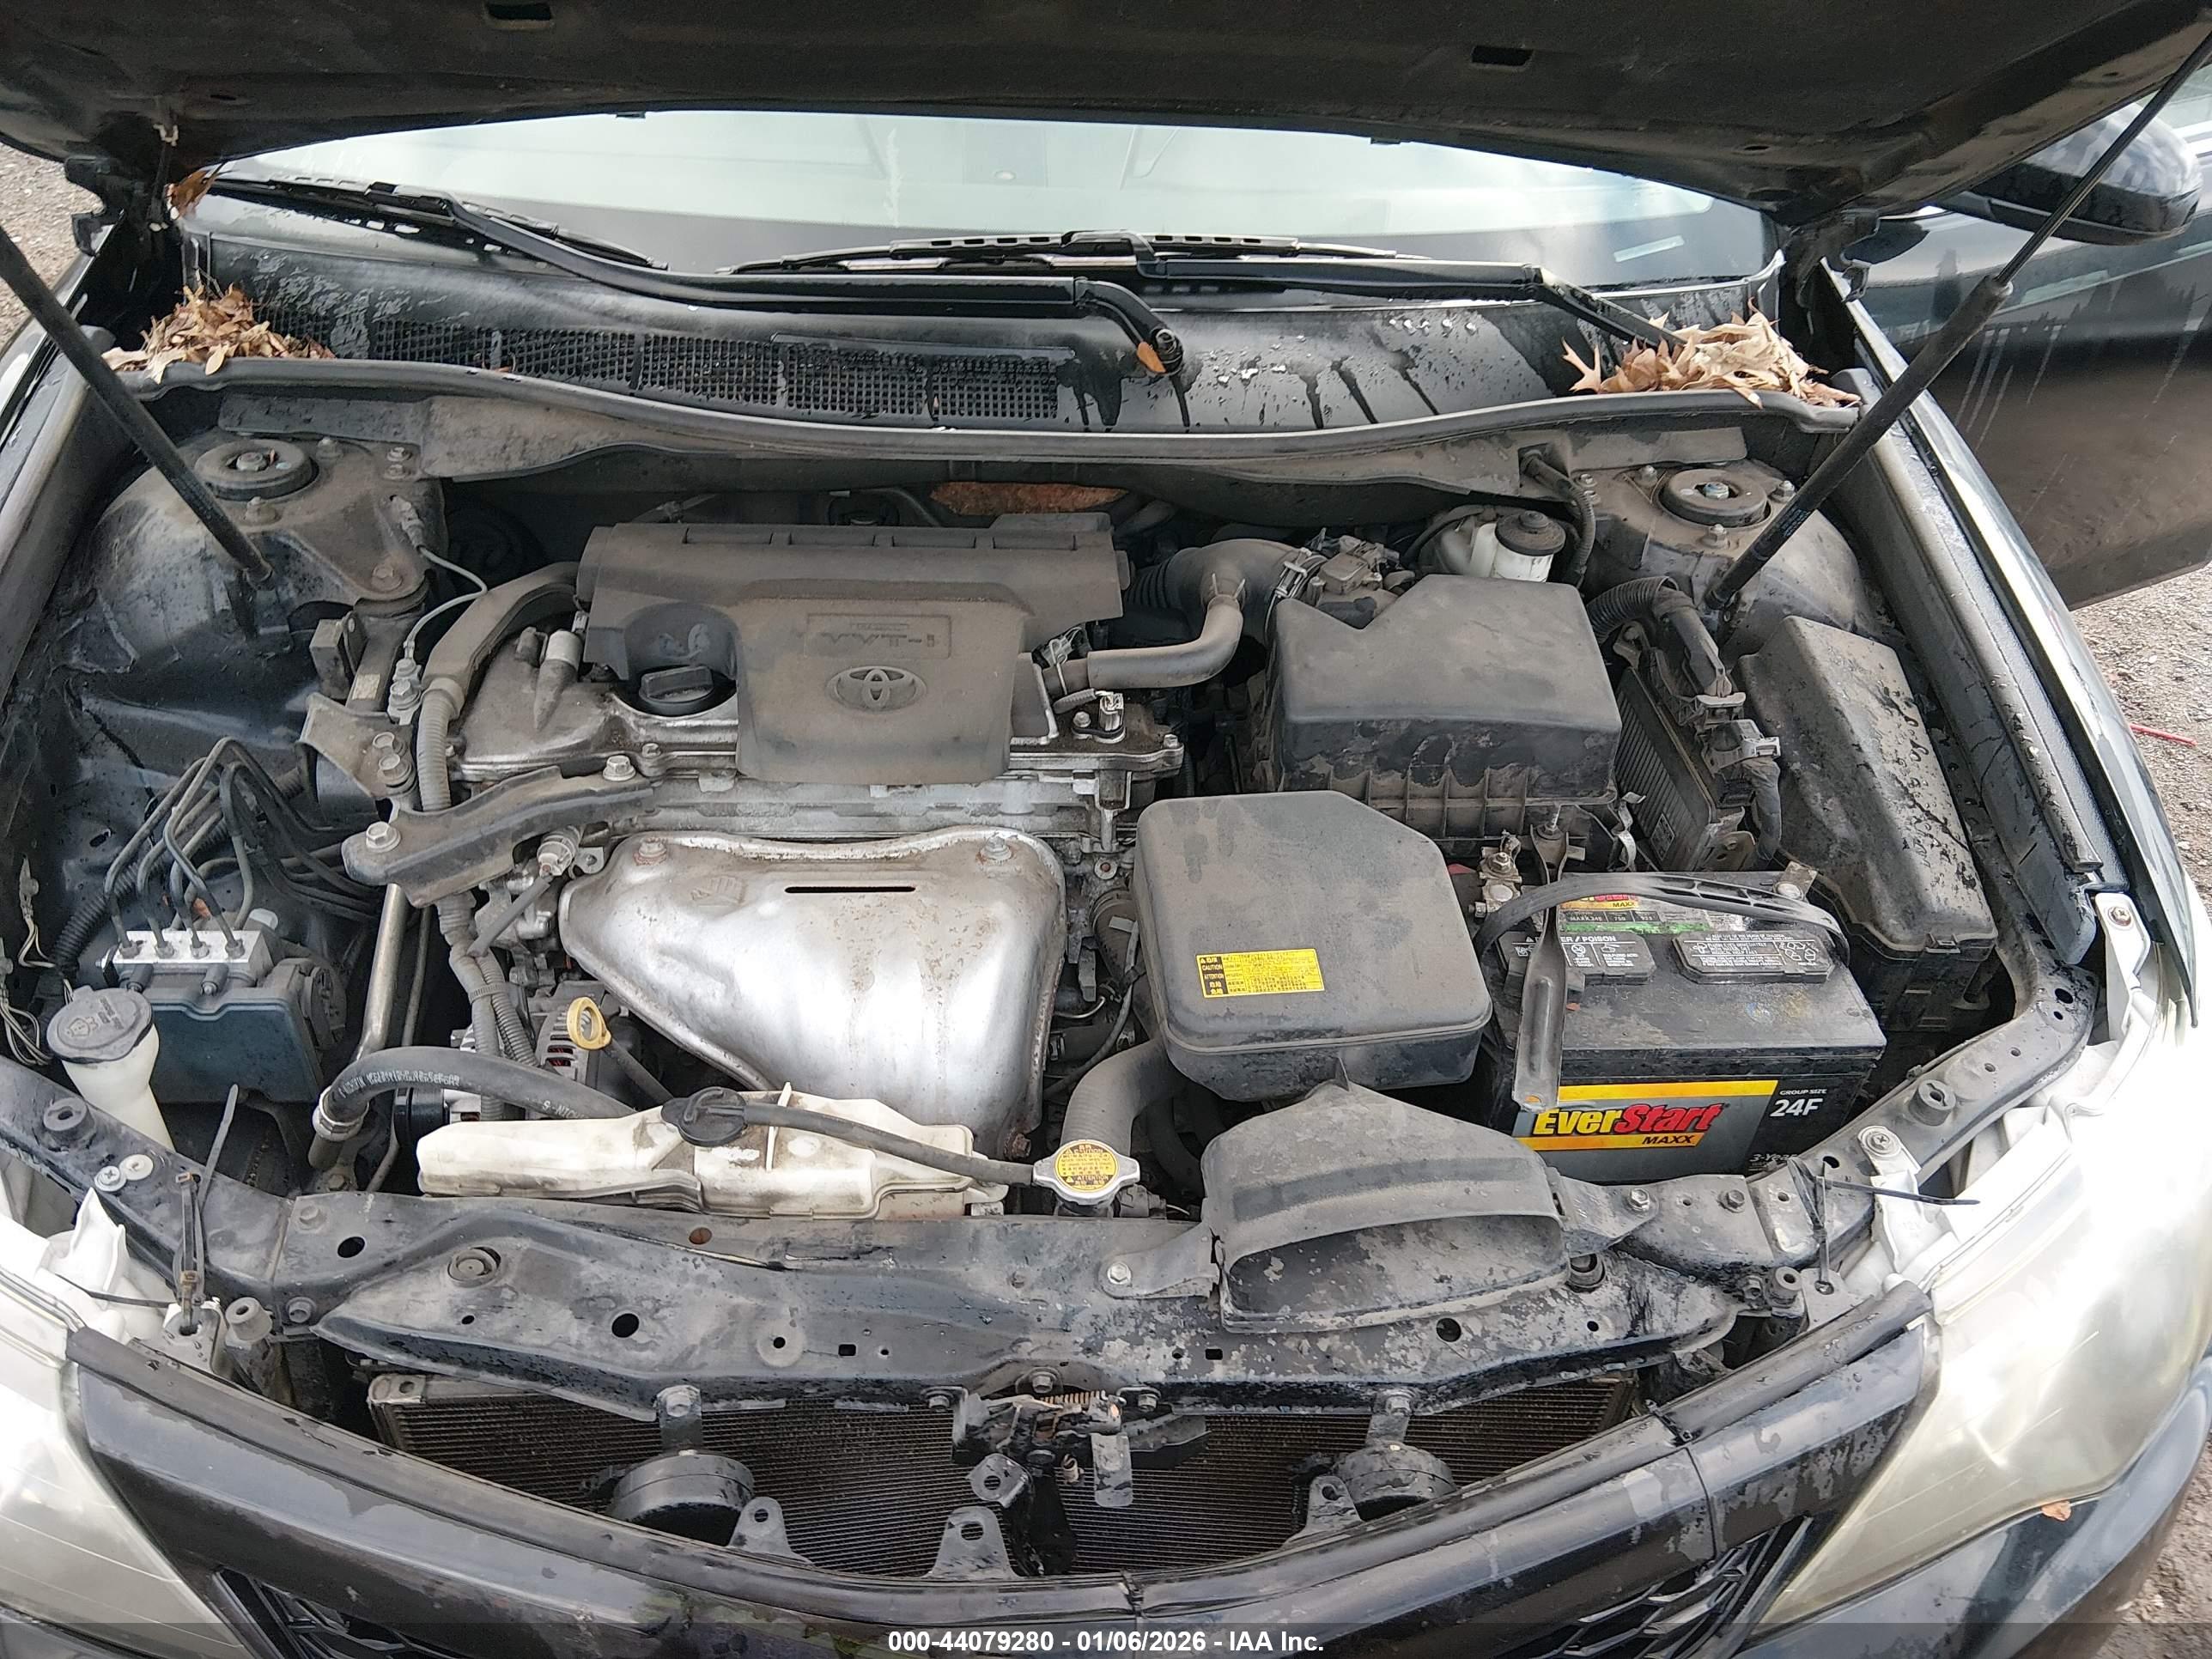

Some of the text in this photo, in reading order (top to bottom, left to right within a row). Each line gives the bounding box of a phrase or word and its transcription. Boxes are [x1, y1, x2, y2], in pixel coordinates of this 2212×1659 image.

[1769, 1097, 1824, 1117] 24F
[1532, 1103, 1725, 1135] EverStart
[1642, 1134, 1695, 1145] MAXX
